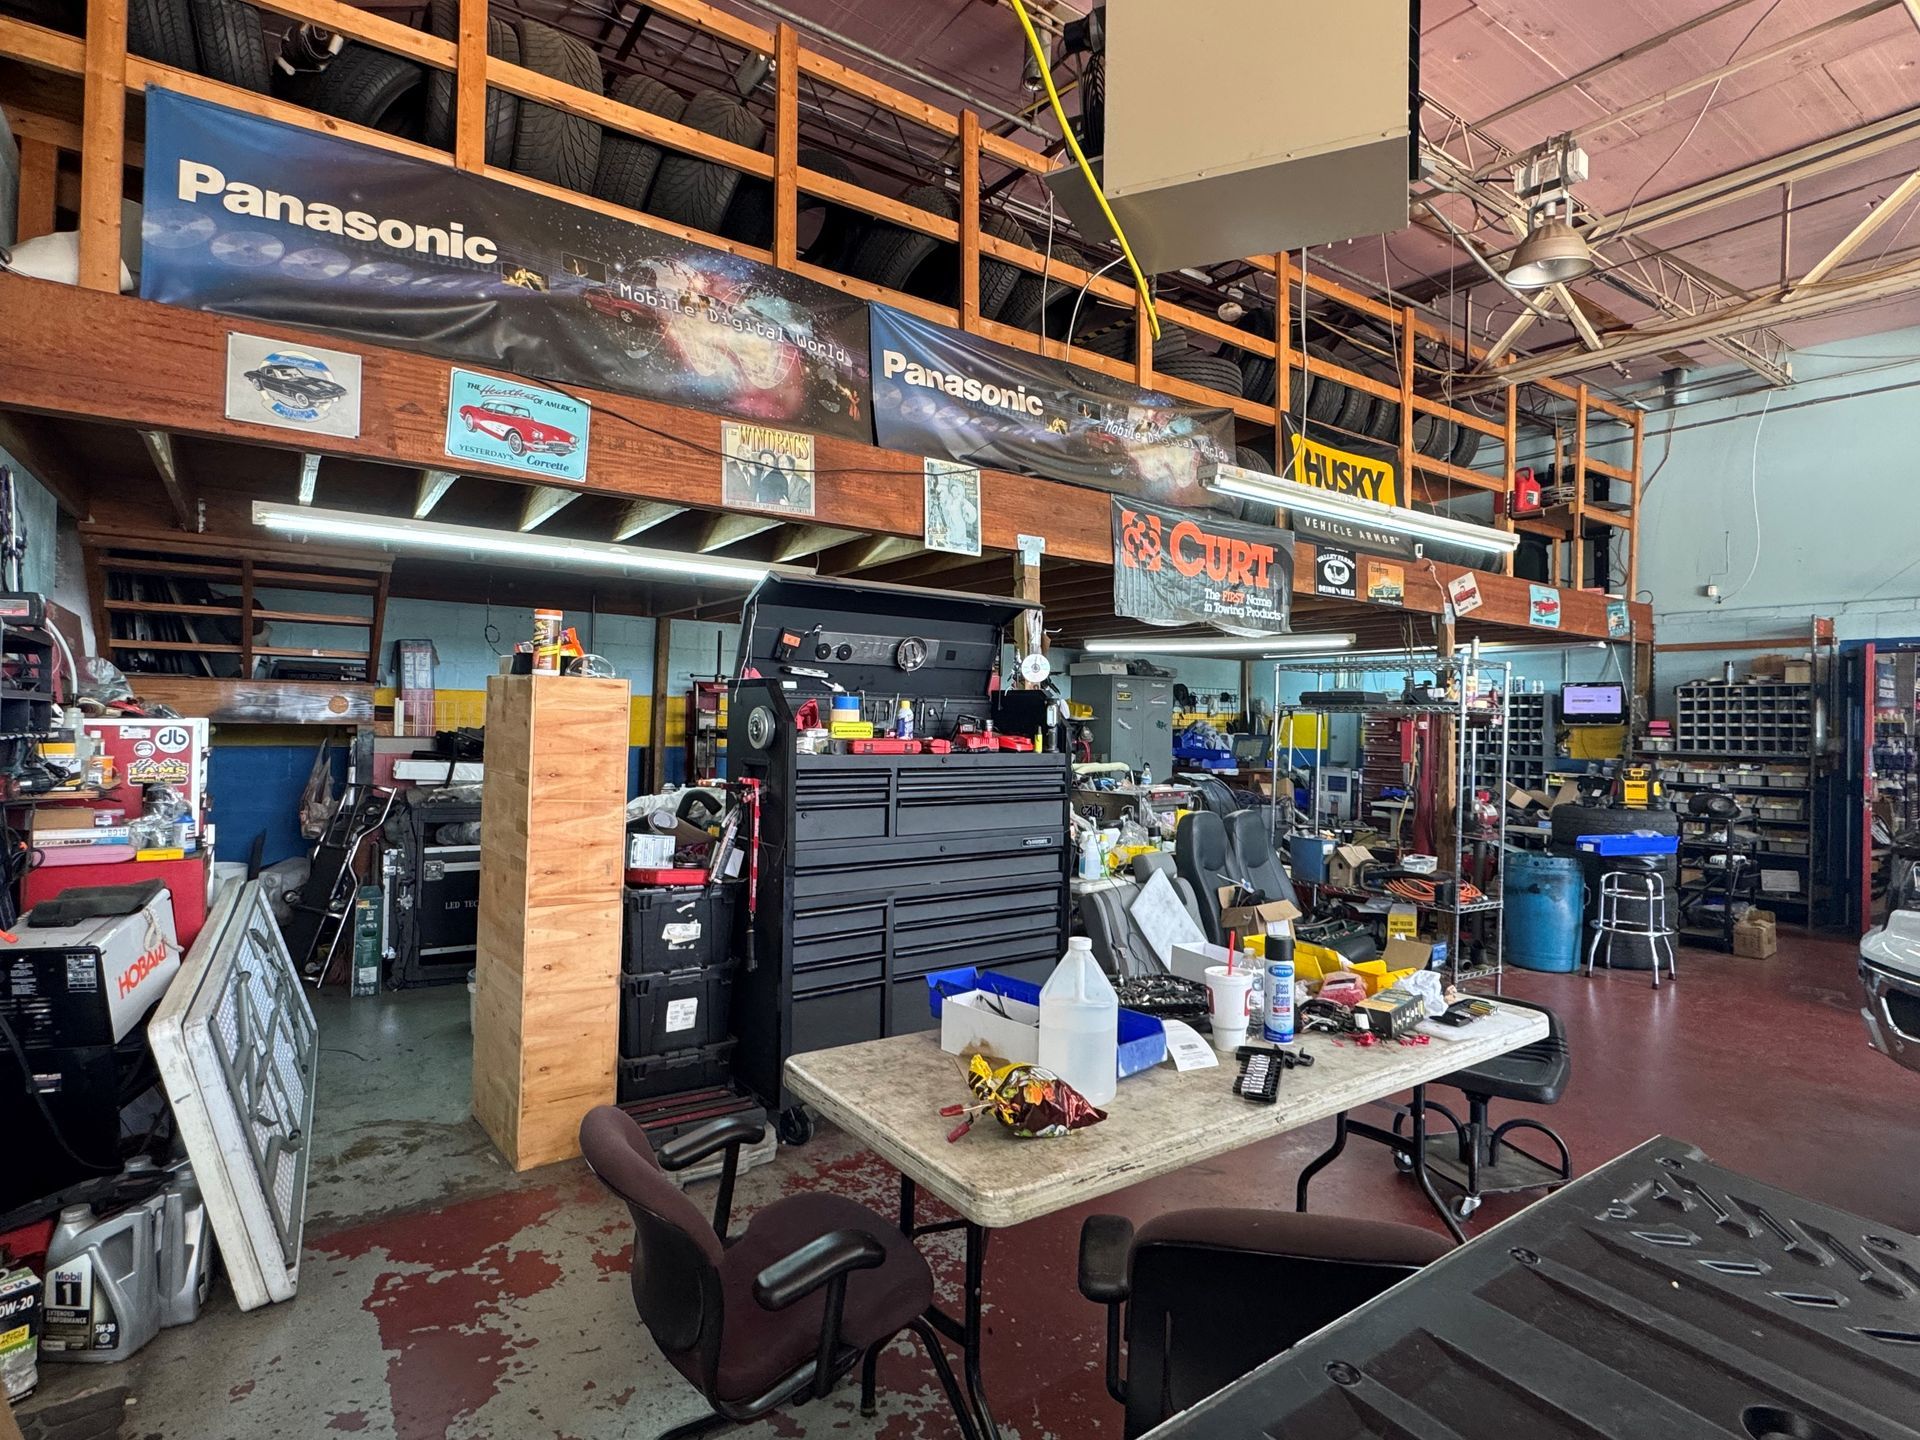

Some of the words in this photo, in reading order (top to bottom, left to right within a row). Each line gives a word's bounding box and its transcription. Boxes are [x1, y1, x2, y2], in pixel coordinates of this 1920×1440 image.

[178, 159, 498, 264] Panasonic
[620, 283, 696, 317] Mobile
[708, 309, 784, 343] Digital
[797, 335, 845, 363] World
[883, 349, 1044, 416] Panasonic
[467, 382, 481, 391] THE
[480, 384, 537, 400] Heartbeat
[544, 401, 577, 413] AMERICA
[738, 425, 809, 460] WINDBAGS
[1105, 420, 1140, 440] Mobile
[1148, 432, 1195, 449] Digital
[1200, 440, 1224, 459] World
[459, 444, 514, 461] YESTERDAY'S
[527, 455, 570, 472] Corvette
[1304, 448, 1385, 502] HUSKY
[1305, 516, 1353, 536] VEHICLE
[1170, 520, 1275, 588] CURT
[1204, 588, 1221, 600] The
[1222, 590, 1245, 603] FIRST
[1246, 593, 1272, 607] Name
[1204, 602, 1213, 612] in
[1213, 603, 1245, 618] Towing
[159, 730, 186, 745] db
[445, 901, 460, 910] LED
[55, 1271, 83, 1281] Mobil
[62, 1283, 72, 1305] 1
[46, 1309, 75, 1317] EXTENDED
[46, 1316, 87, 1324] PERFORMANCE
[95, 1323, 116, 1333] 5W-30
